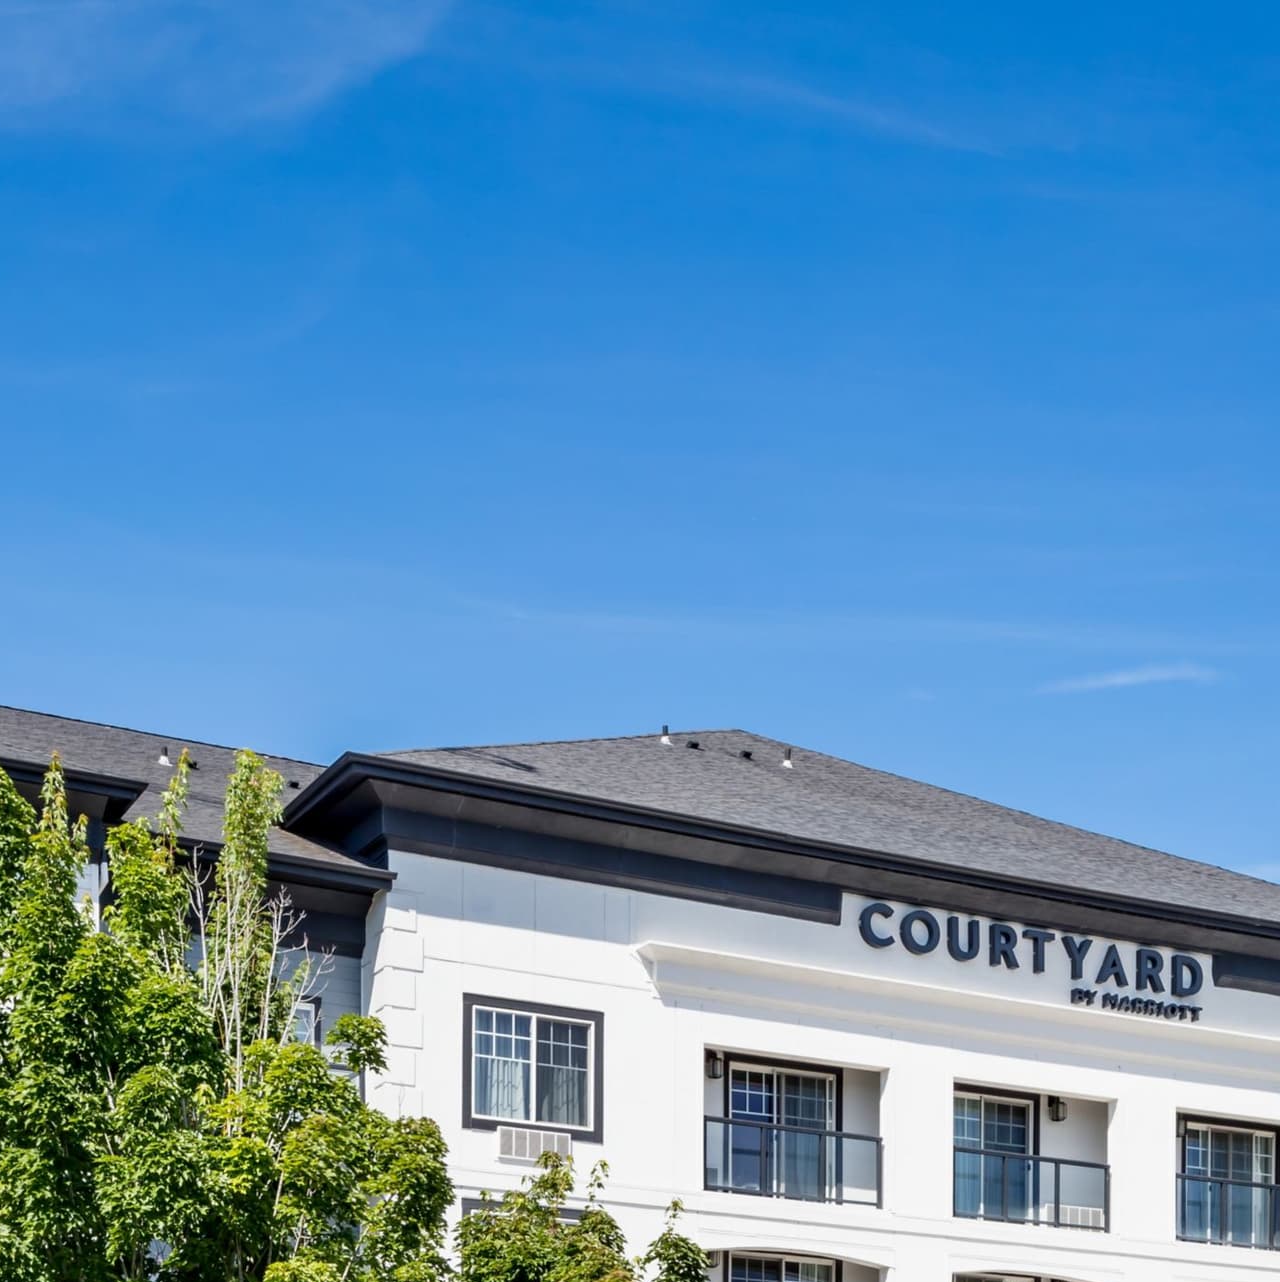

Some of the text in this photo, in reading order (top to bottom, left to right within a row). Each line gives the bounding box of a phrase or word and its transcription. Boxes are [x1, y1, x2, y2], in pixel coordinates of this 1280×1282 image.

[858, 902, 1204, 997] COURTYARD
[1070, 987, 1203, 1022] BY MARRIOTT
